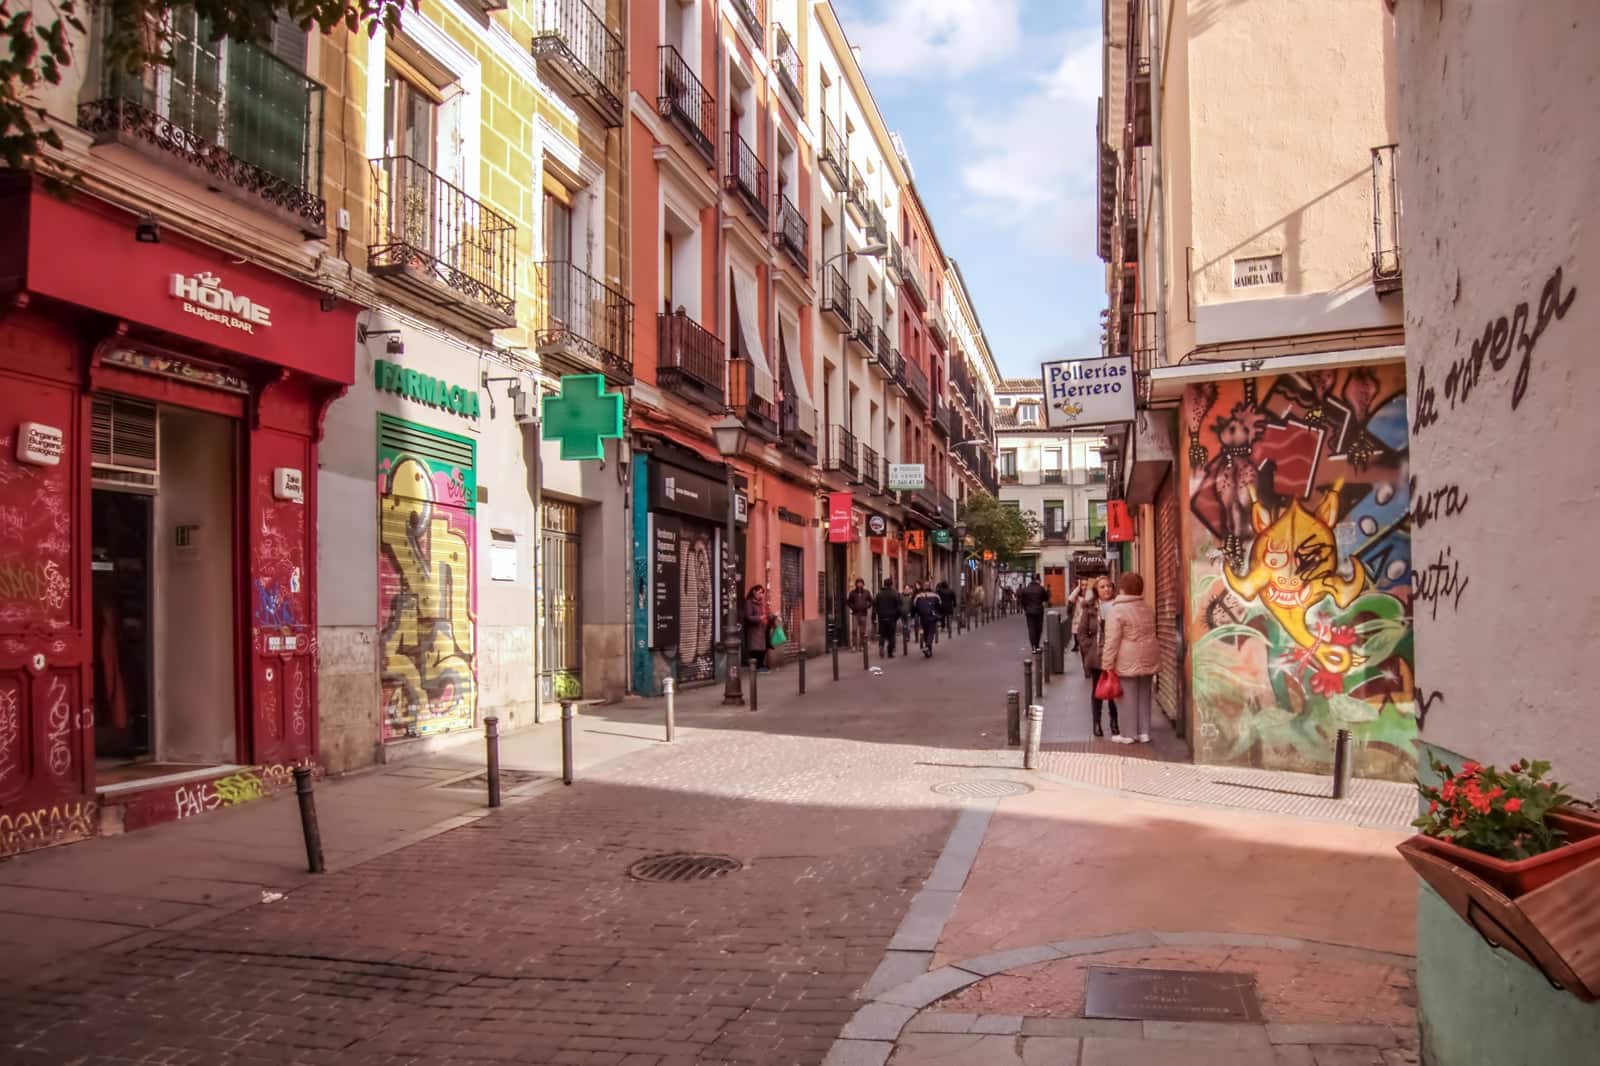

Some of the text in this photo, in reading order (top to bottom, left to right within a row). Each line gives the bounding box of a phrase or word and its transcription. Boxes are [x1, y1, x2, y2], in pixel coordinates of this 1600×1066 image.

[171, 272, 272, 327] HOME
[230, 317, 254, 335] BAR
[1050, 362, 1127, 383] Pollerías
[374, 359, 481, 418] FARMACIA
[1053, 382, 1122, 399] Herrero
[30, 428, 62, 443] Organic
